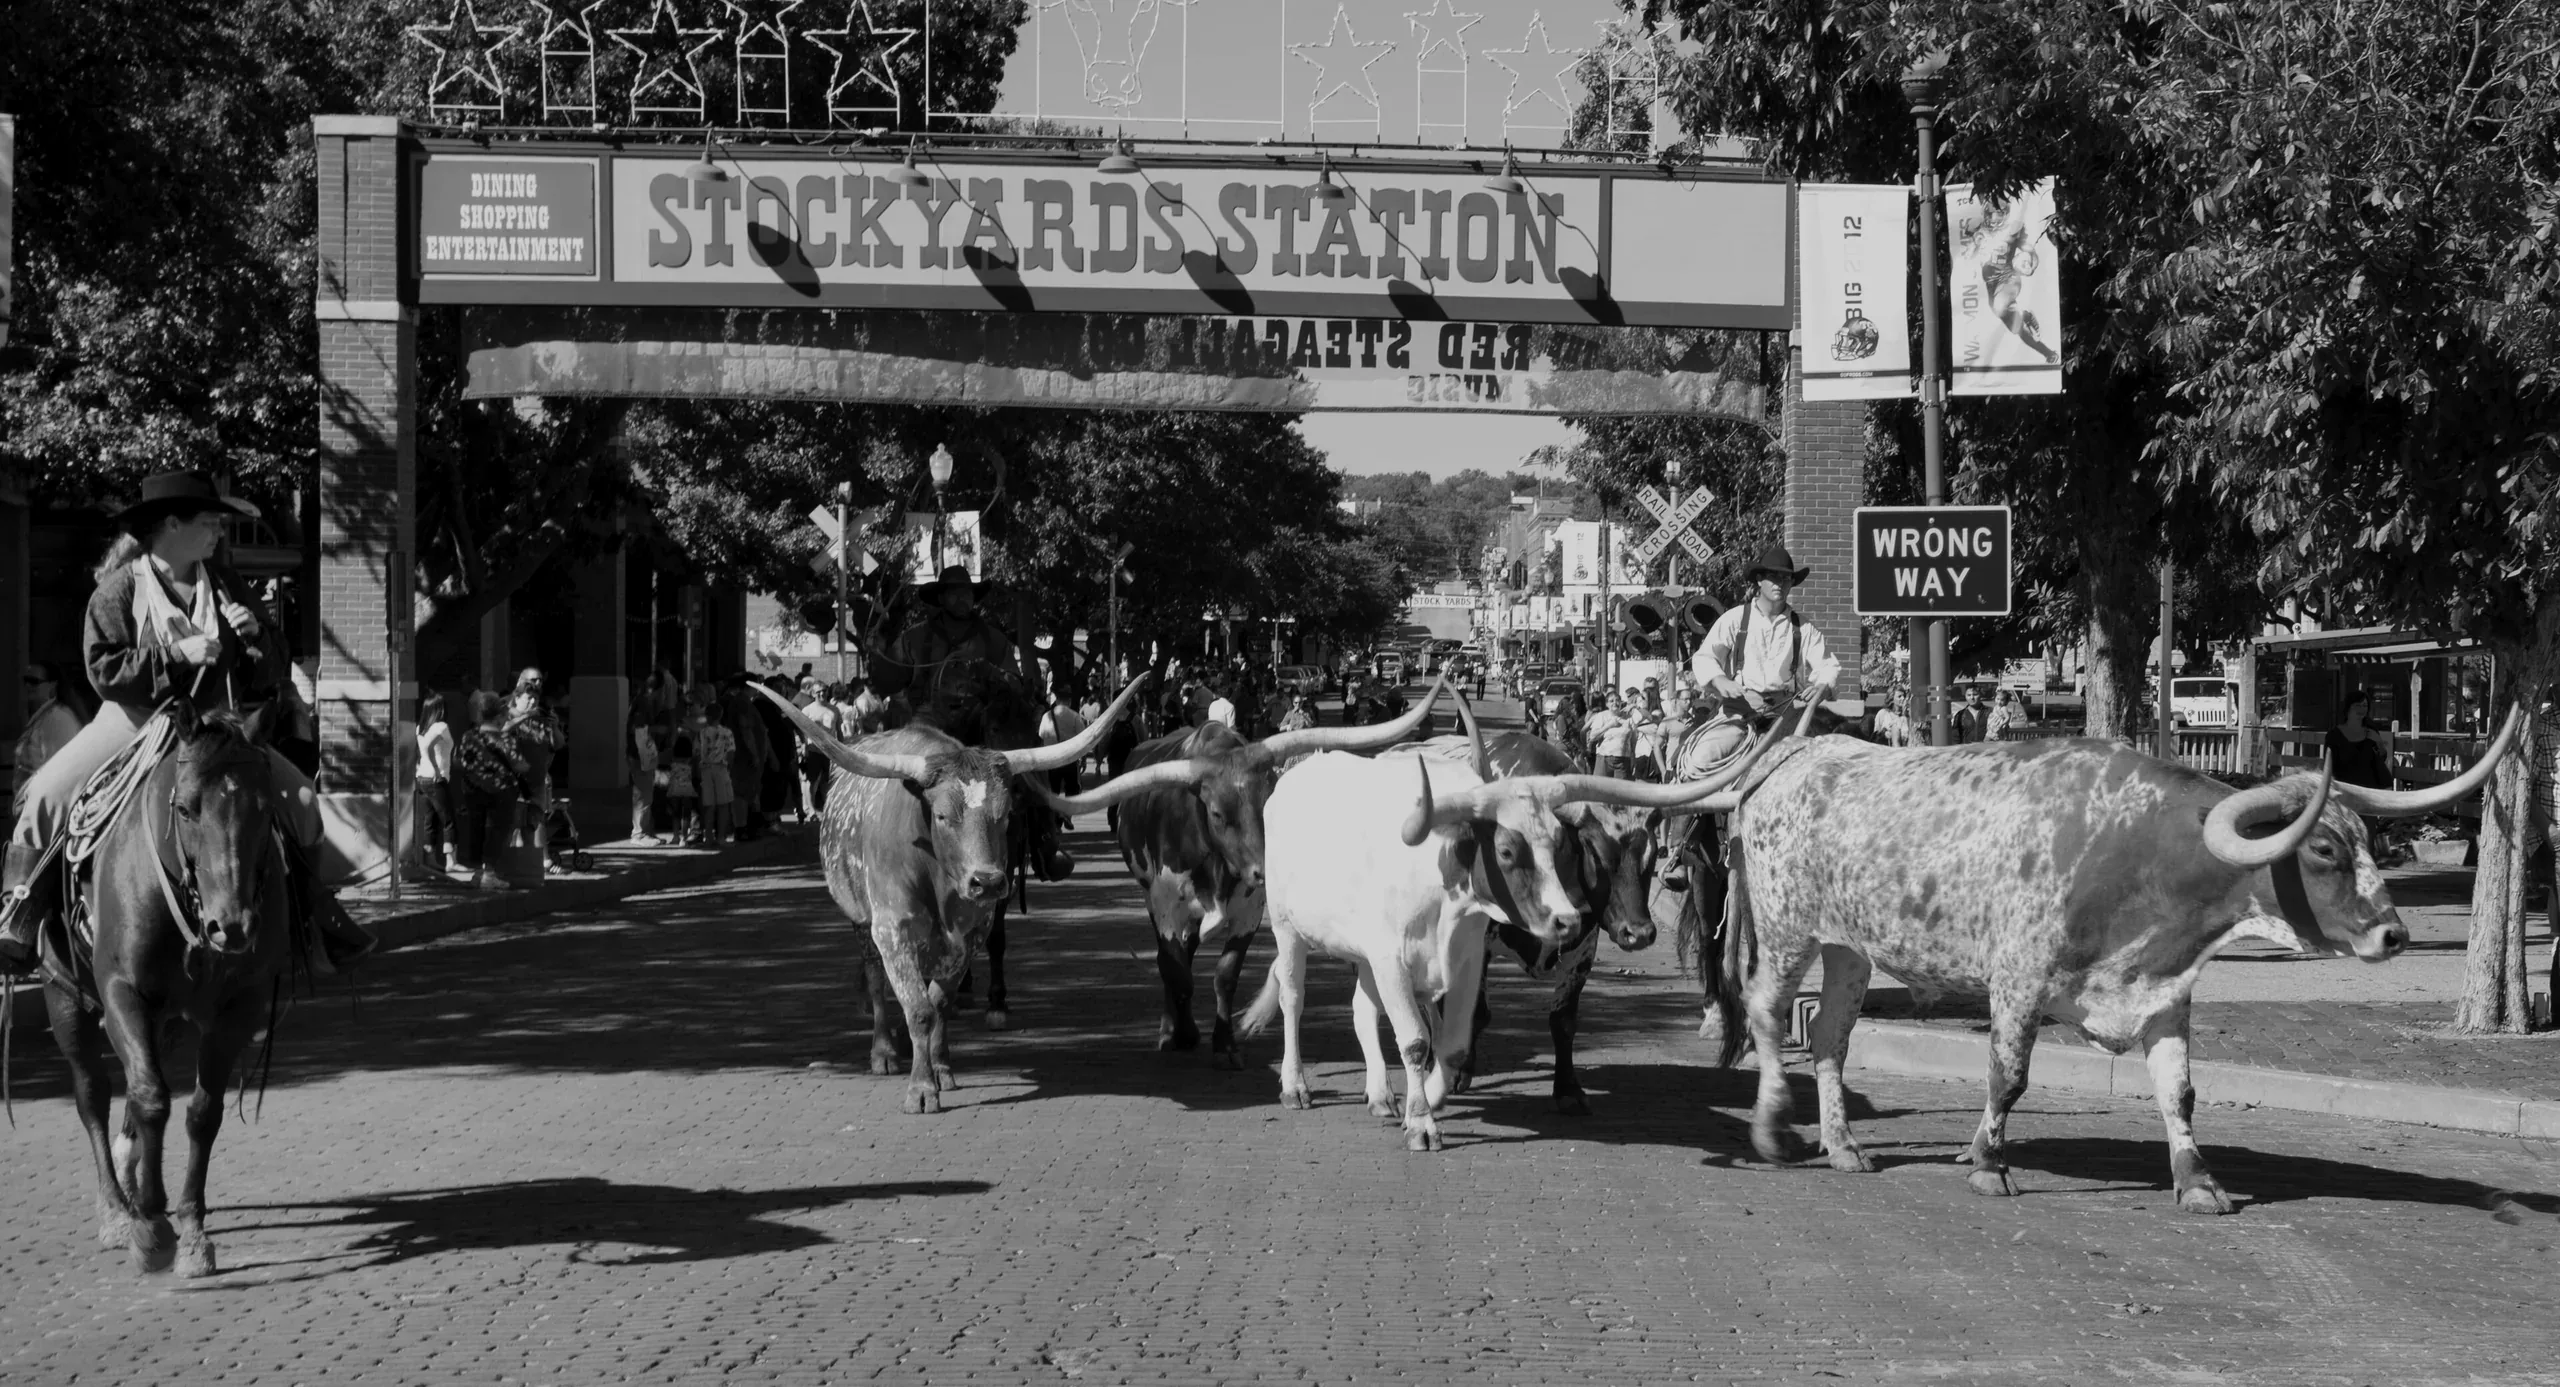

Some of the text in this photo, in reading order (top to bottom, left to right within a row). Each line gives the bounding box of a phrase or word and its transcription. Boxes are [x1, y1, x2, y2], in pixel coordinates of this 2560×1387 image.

[470, 173, 537, 199] DINING
[459, 205, 550, 230] SHOPPING
[648, 174, 1564, 285] STOCKYARDS STATION
[426, 236, 584, 263] ENTERTAINMENT
[1844, 282, 1862, 320] BIG
[1641, 489, 1709, 559] RAIL ROAD
[1643, 492, 1707, 556] CROSSING
[1873, 526, 1994, 559] WRONG
[1894, 567, 1971, 598] WAY
[1413, 597, 1472, 606] STOCK YARDS
